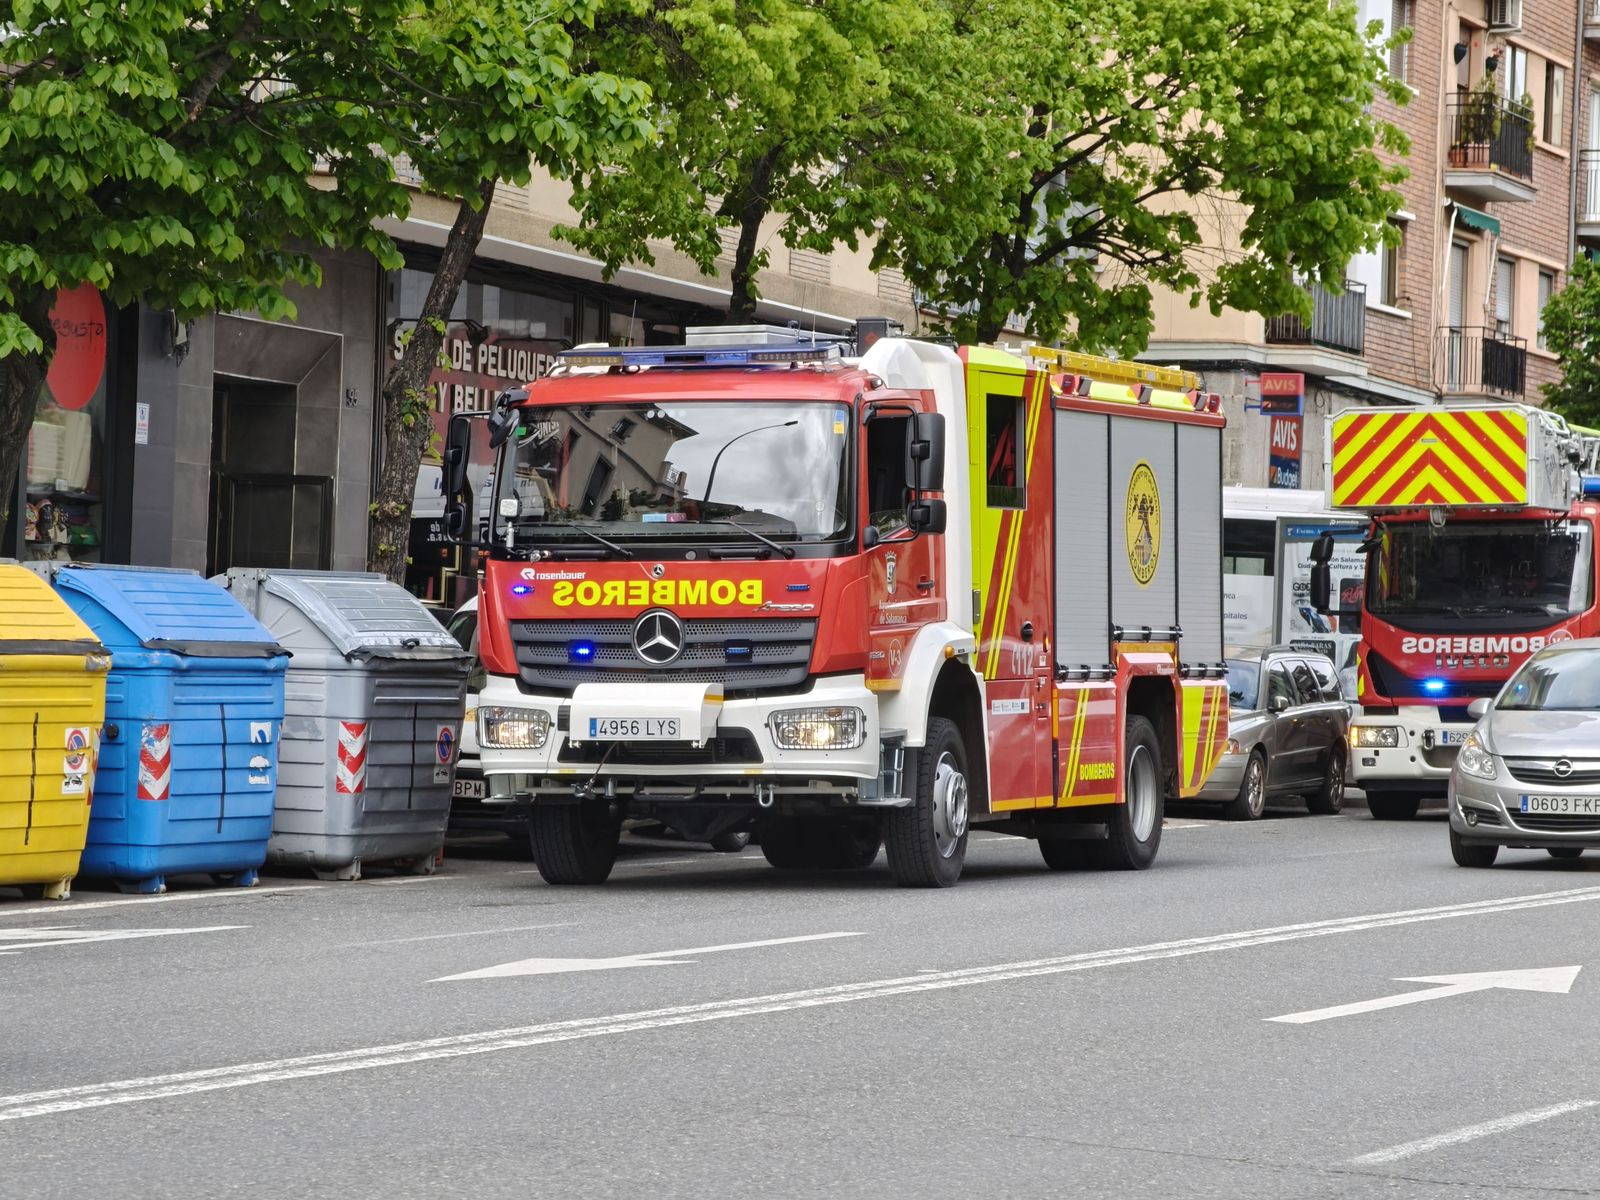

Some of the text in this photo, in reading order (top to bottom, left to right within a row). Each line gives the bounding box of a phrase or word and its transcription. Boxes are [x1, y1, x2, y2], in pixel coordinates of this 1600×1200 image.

[51, 317, 104, 344] egusta
[453, 338, 472, 372] DE
[1264, 379, 1296, 391] AVIS
[437, 381, 448, 413] Y
[1272, 419, 1297, 452] AVIS
[1277, 466, 1298, 488] Budget
[536, 570, 586, 580] rosenbauer
[1435, 654, 1510, 669] IVECO
[599, 720, 677, 736] 4956 LYS
[1449, 731, 1468, 743] 629
[1080, 762, 1115, 780] BOMBEROS
[454, 780, 482, 796] BPM
[1531, 797, 1569, 812] 0603
